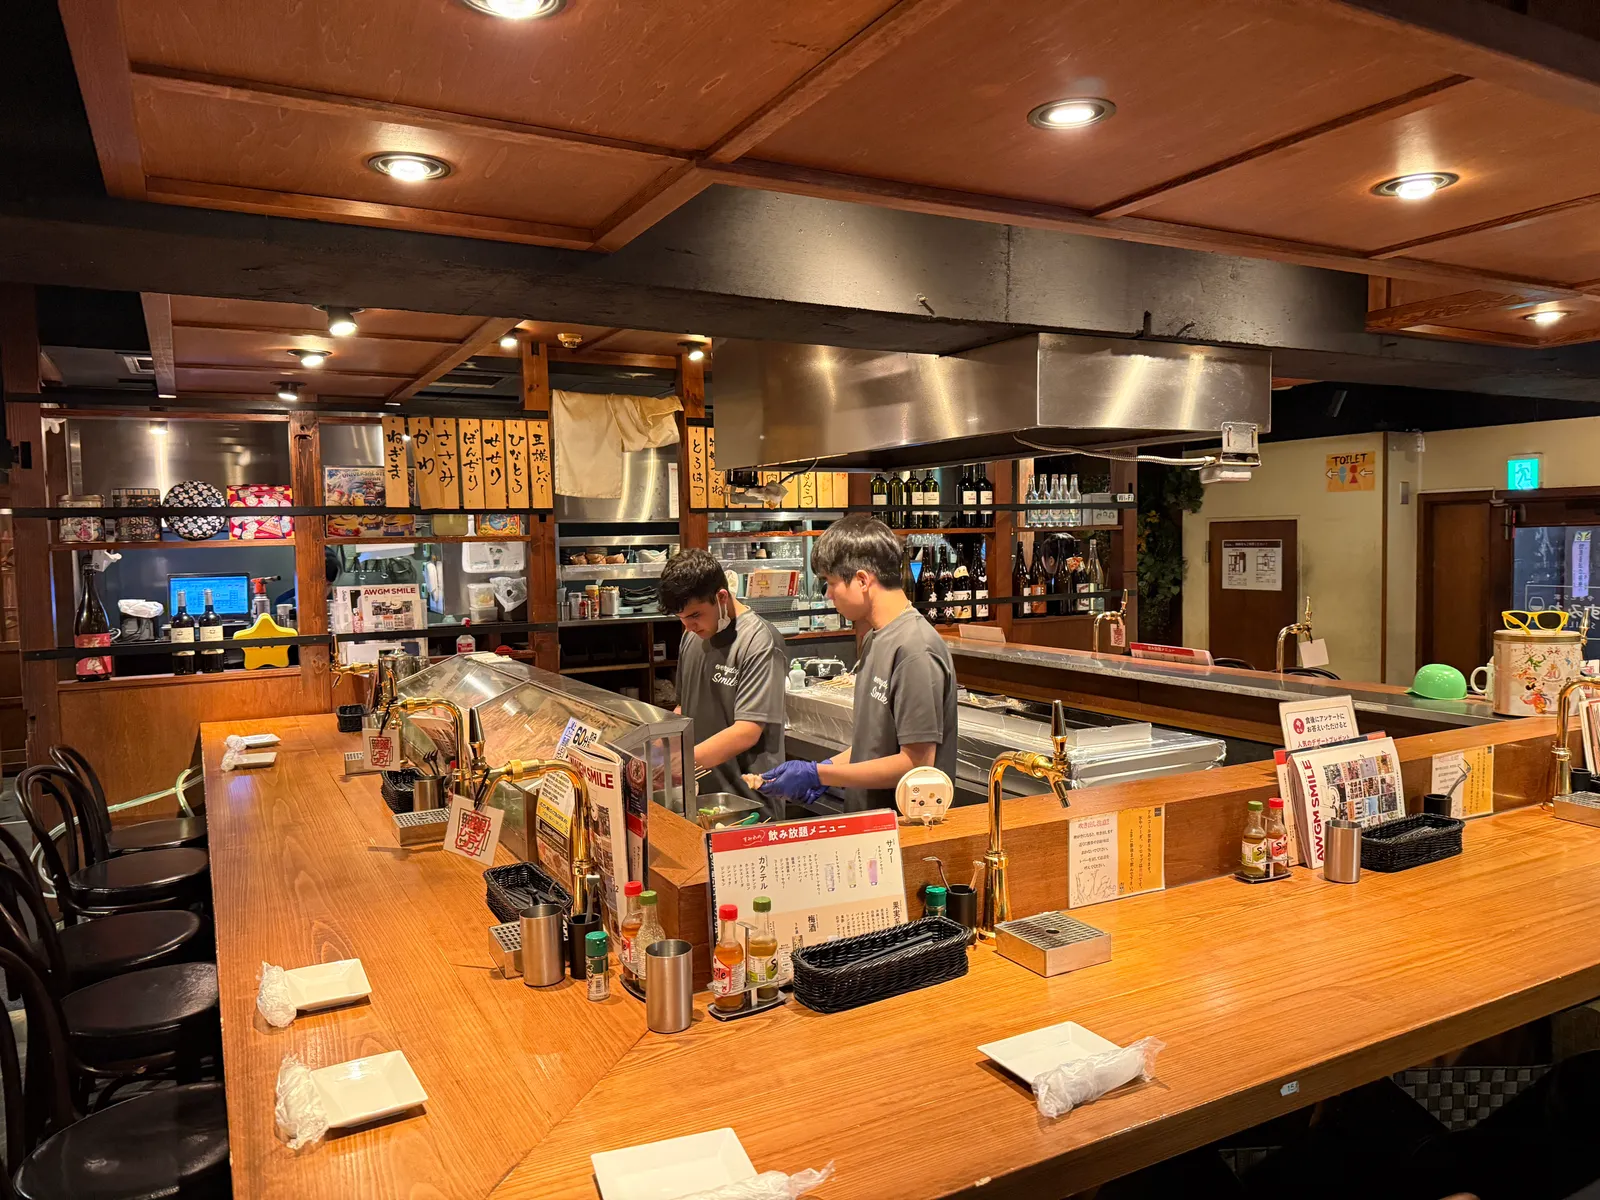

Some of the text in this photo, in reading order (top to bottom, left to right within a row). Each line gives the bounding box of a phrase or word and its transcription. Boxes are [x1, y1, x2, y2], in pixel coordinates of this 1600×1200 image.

[386, 430, 405, 481] ねぎま
[413, 429, 435, 475] かわ
[436, 430, 456, 488] ささみ
[484, 433, 501, 486] せせり
[508, 433, 525, 493] ひなとろ
[692, 438, 705, 496] とろはつ
[1331, 453, 1368, 466] TOILET
[363, 587, 416, 596] AWGM SMILE
[711, 672, 739, 687] Smile
[586, 767, 615, 790] SMILE
[1301, 758, 1321, 809] SMILE
[767, 824, 847, 842] 飲み放題メニュー
[885, 839, 894, 864] サワー
[758, 856, 769, 891] カクテル
[807, 914, 817, 933] 梅酒
